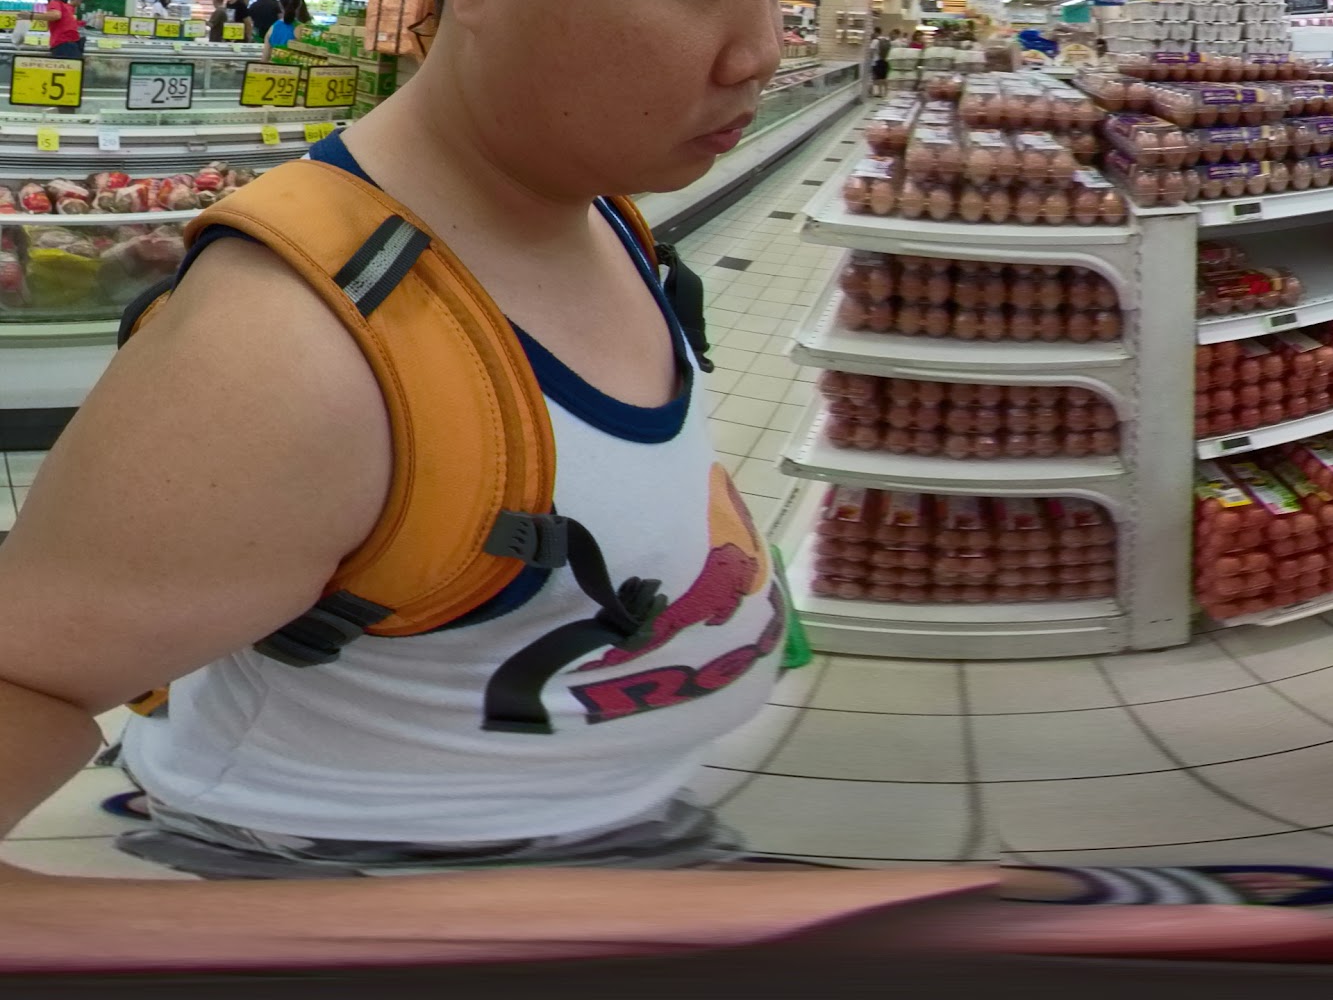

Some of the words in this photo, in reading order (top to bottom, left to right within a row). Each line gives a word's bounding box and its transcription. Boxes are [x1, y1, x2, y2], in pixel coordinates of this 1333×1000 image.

[21, 61, 73, 70] SPECIAL
[253, 67, 294, 75] SPECIAL
[41, 72, 66, 100] $5
[151, 77, 188, 104] 2.85
[261, 76, 296, 101] 2.95
